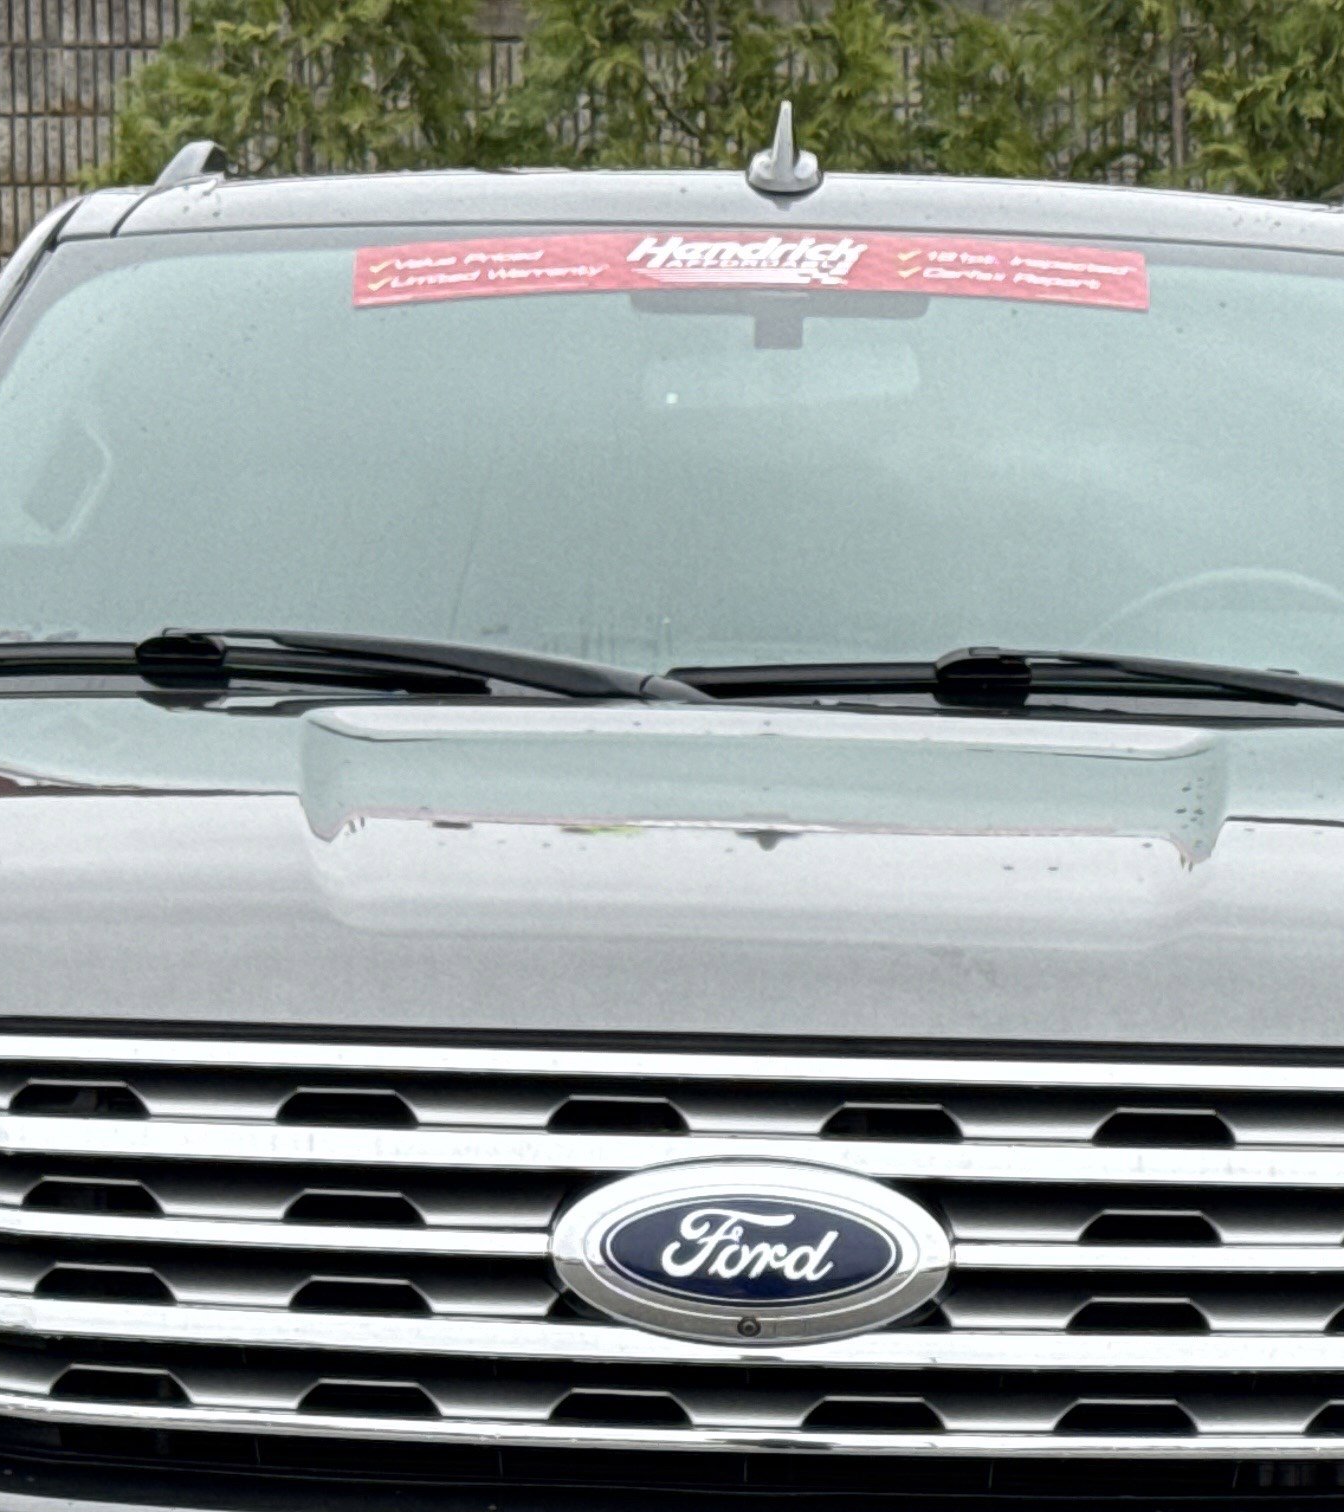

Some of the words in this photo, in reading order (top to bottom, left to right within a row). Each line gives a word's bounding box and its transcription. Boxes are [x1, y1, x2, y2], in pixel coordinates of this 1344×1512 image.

[487, 263, 611, 281] Warranty
[626, 235, 868, 276] Hendrick
[661, 1208, 839, 1282] Ford
